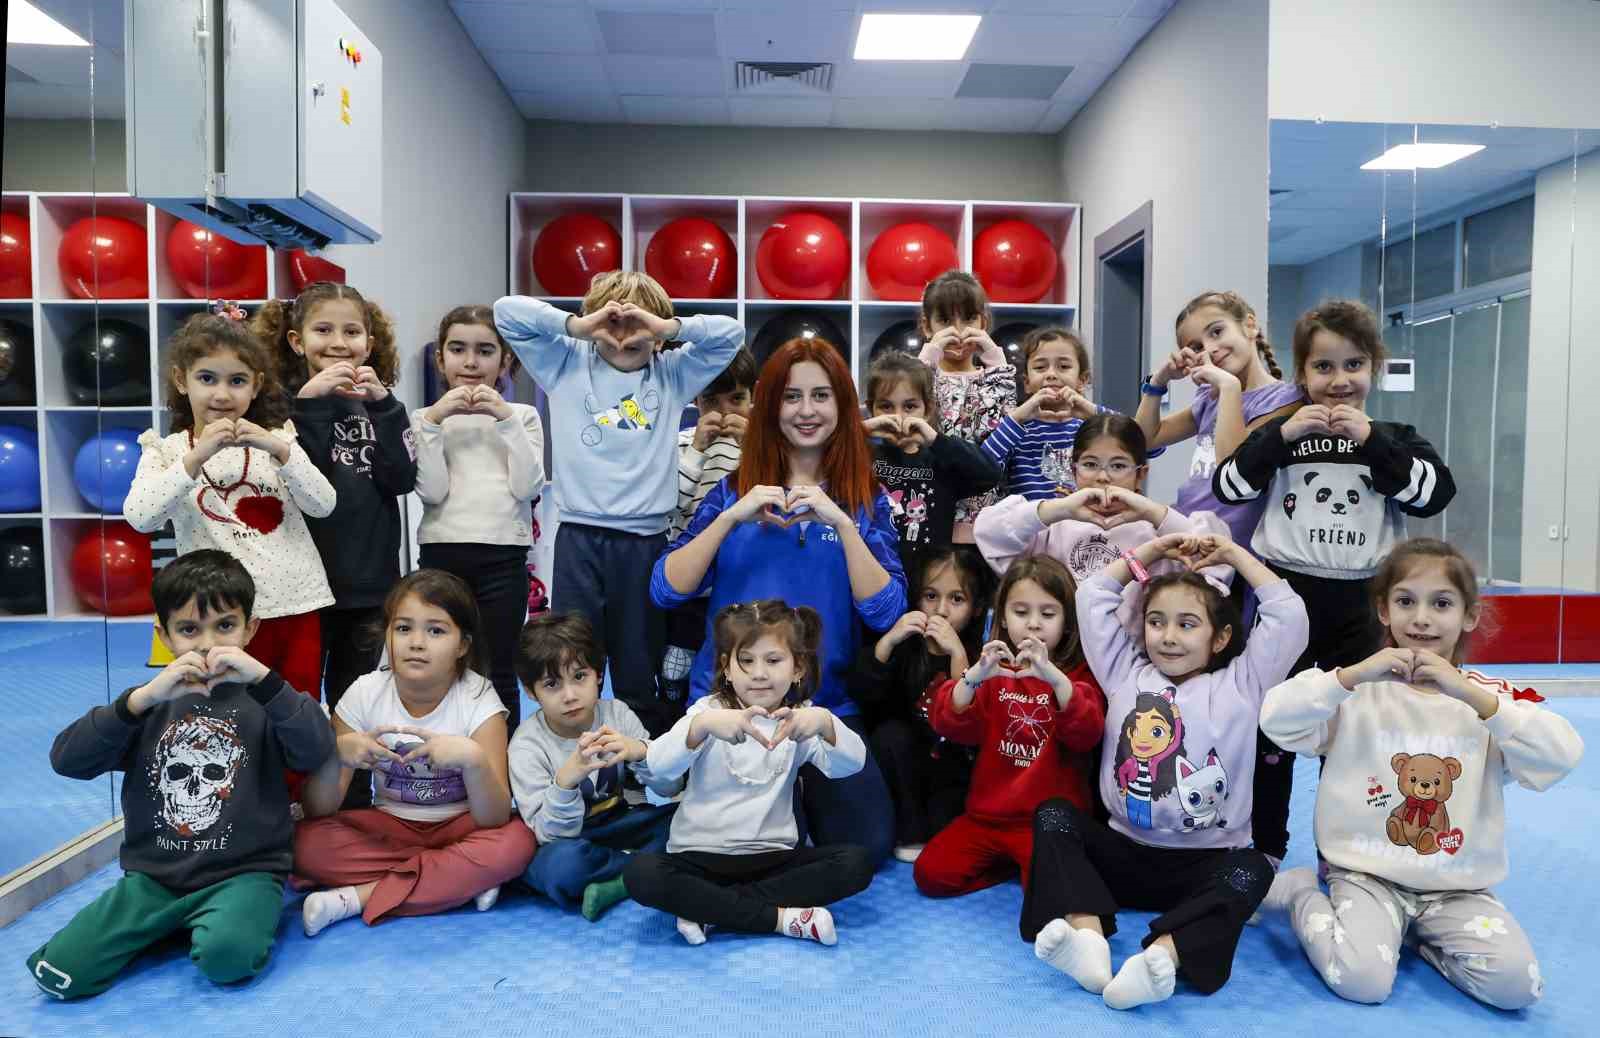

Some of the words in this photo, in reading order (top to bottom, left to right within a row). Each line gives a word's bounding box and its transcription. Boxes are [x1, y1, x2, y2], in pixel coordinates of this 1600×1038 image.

[1337, 439, 1358, 453] BE
[1309, 528, 1366, 546] FRIEND
[156, 835, 190, 852] PAINT
[193, 837, 228, 852] STYLE
